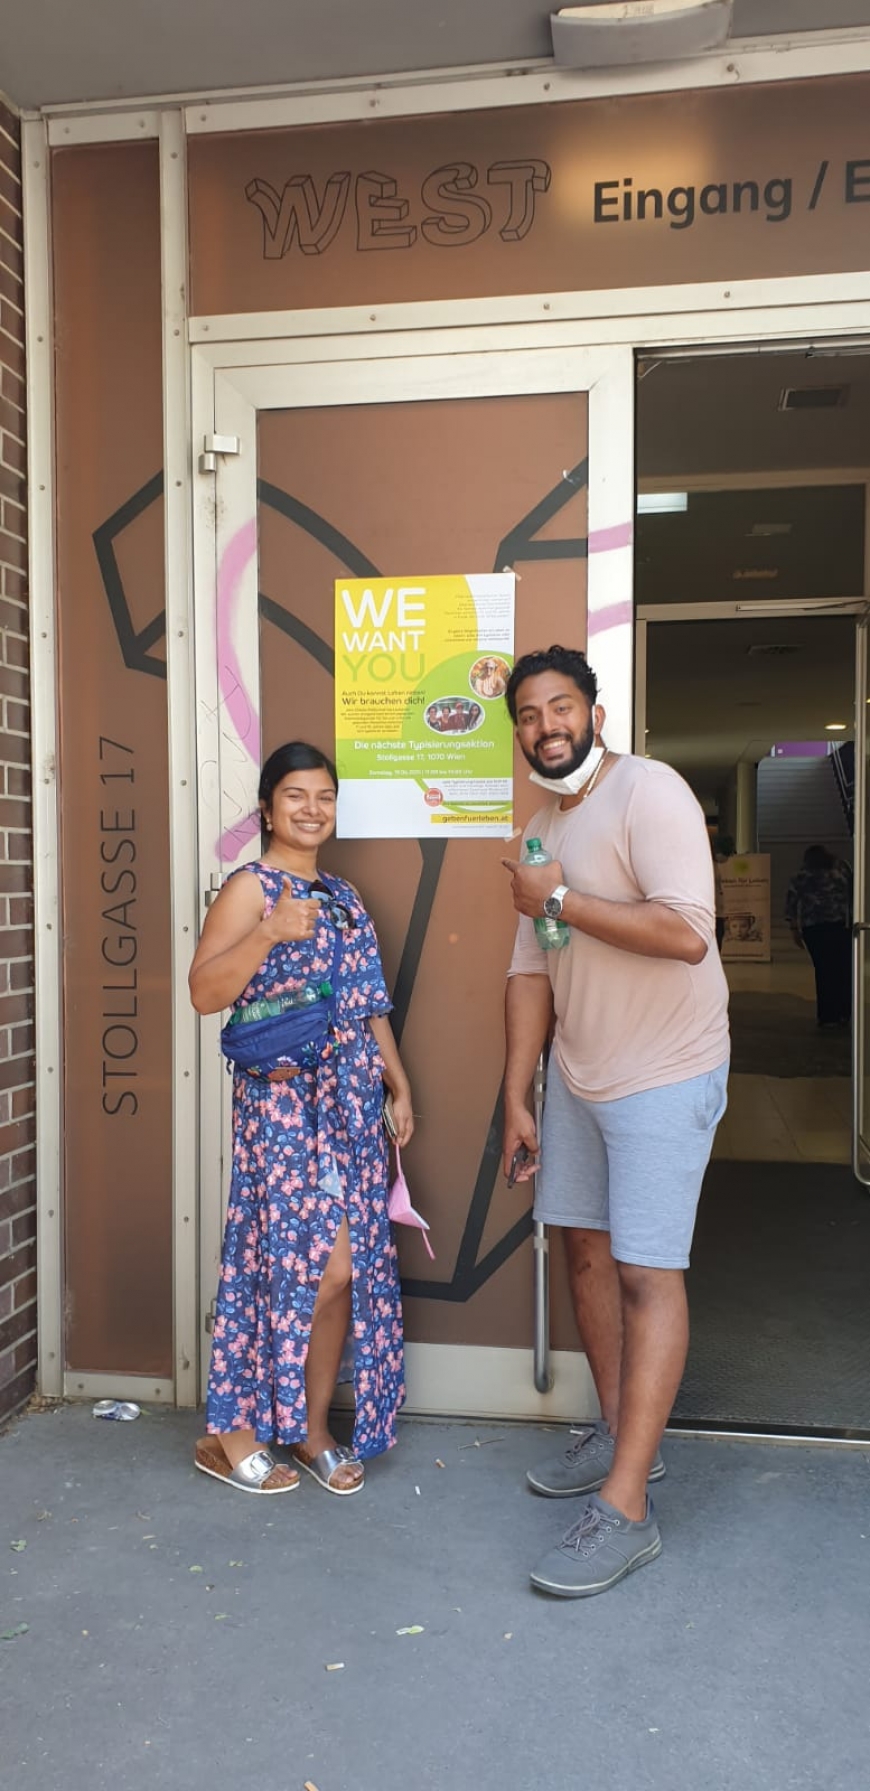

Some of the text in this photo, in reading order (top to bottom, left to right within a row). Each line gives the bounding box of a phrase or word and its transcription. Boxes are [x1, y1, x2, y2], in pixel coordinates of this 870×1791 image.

[592, 177, 794, 230] Eingang
[807, 161, 830, 210] /
[244, 158, 552, 260] WEST
[341, 587, 426, 628] WE
[342, 630, 425, 653] WANT
[342, 653, 426, 682] YOU
[341, 696, 425, 705] Wir brauchen dich!
[354, 740, 495, 751] Die nächste Typisierungsaktion
[376, 753, 415, 762] Stollgasse
[447, 753, 466, 761] Wien
[442, 815, 509, 824] gebenfuerleben.at
[98, 735, 138, 1116] STOLLGASSE 17
